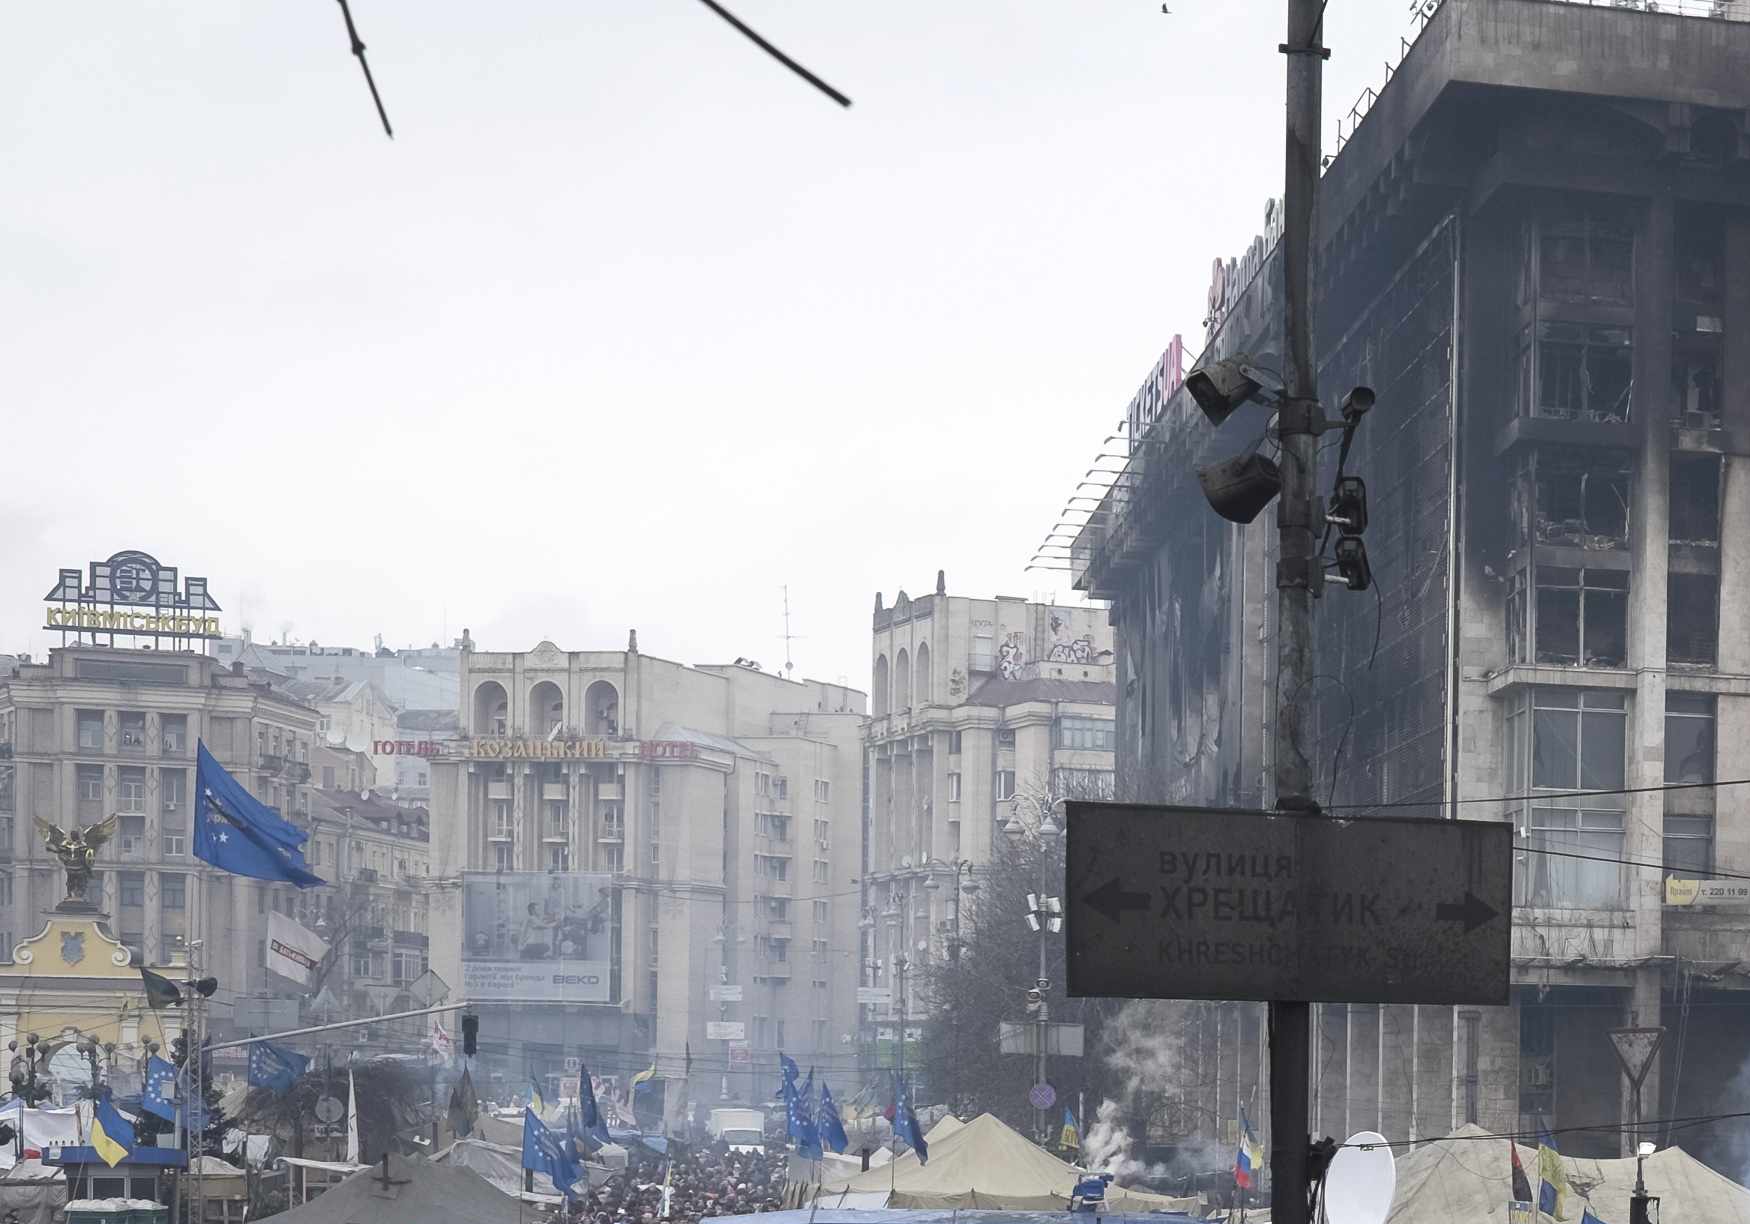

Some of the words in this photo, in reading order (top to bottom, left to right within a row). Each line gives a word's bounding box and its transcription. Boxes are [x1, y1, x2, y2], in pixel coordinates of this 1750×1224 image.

[47, 606, 222, 636] КИЇВМІСЬКБУД
[472, 738, 607, 761] КОЗАЦЬКИЙ
[1160, 886, 1382, 926] ХРЕЩАТИК
[552, 975, 600, 985] BEKO
